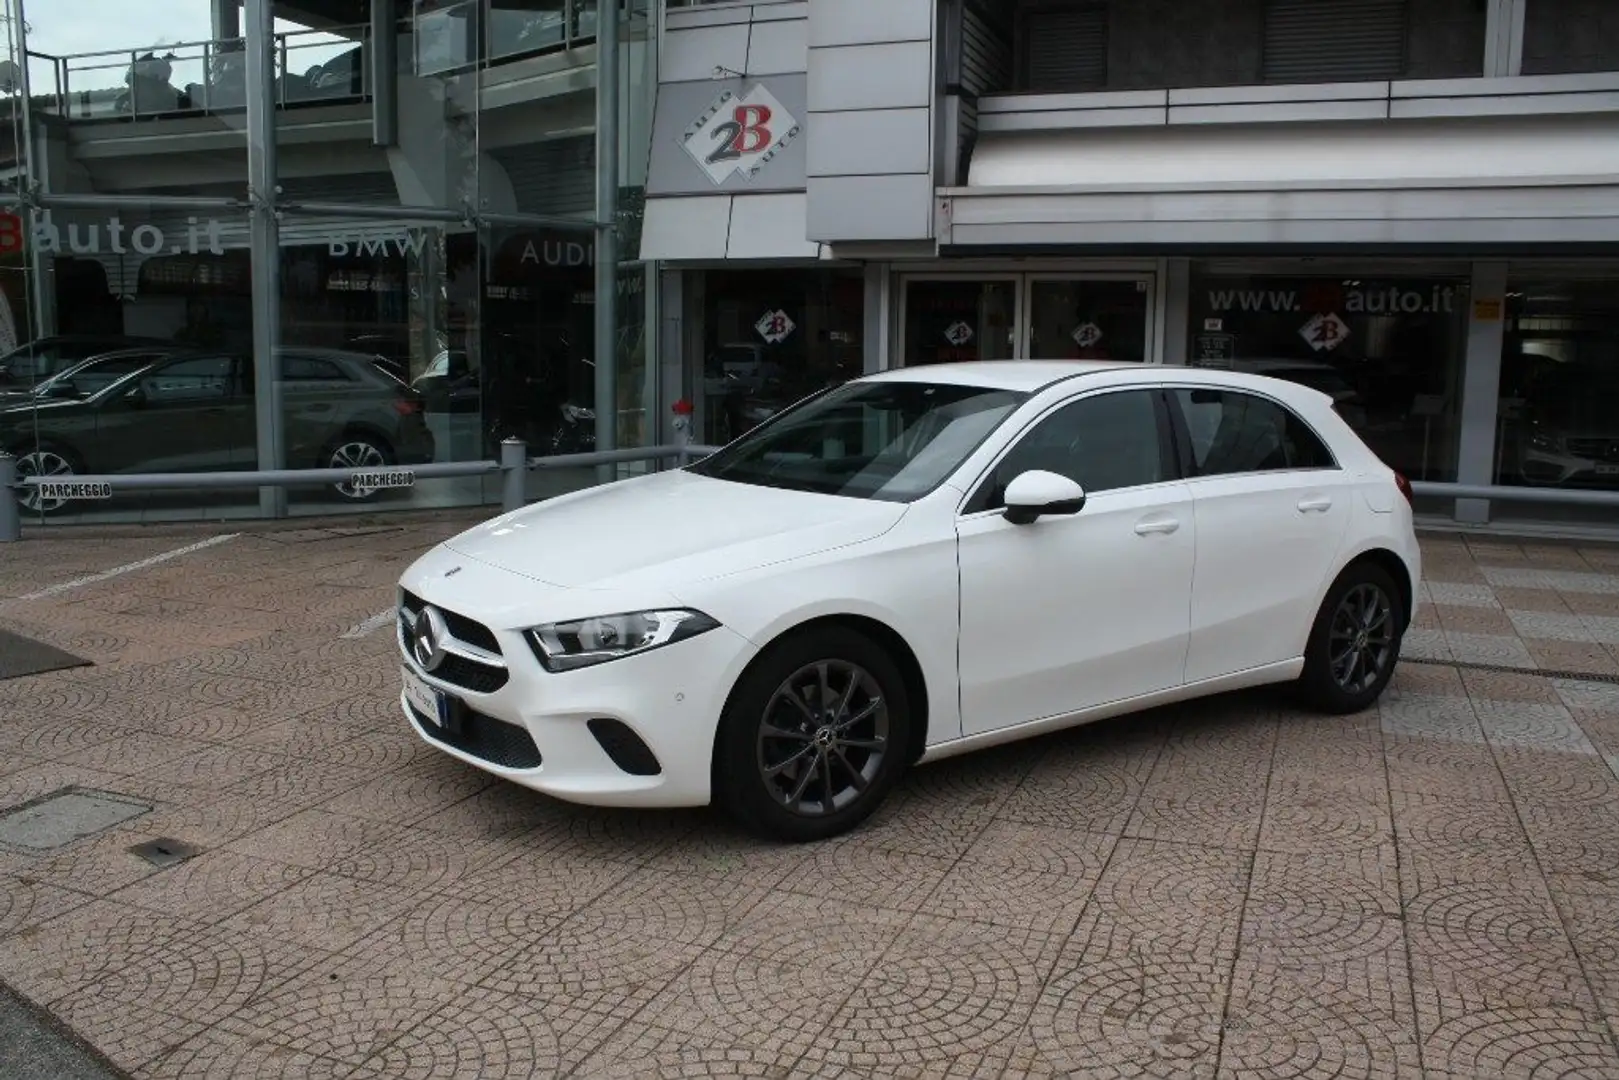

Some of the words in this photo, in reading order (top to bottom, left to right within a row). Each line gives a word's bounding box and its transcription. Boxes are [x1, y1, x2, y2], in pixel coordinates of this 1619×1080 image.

[705, 104, 772, 165] 2B
[328, 231, 428, 258] BMW
[520, 239, 593, 267] AUDI
[41, 483, 111, 497] PARCHEGGIO
[352, 471, 414, 487] PARCHEGGIO
